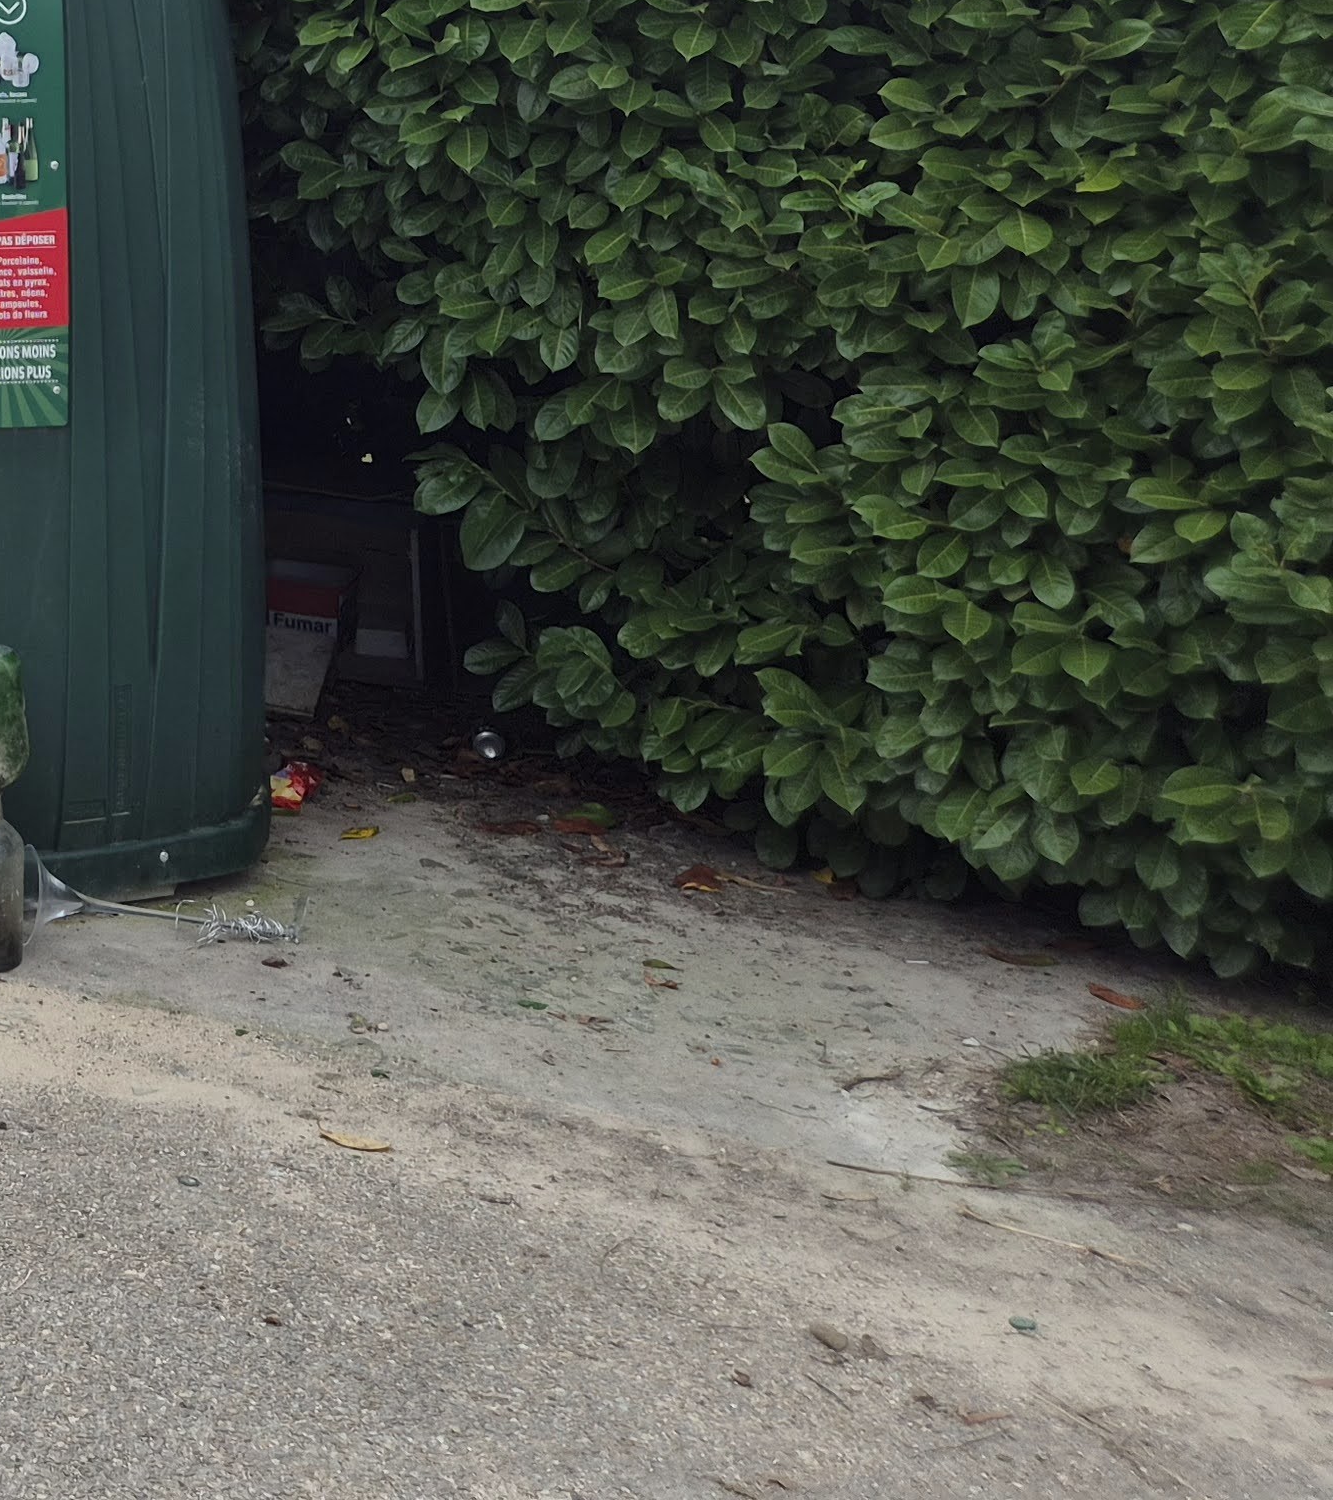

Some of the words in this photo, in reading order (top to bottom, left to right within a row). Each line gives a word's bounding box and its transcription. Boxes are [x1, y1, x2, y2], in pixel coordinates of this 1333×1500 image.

[15, 232, 55, 246] DÉPOSER
[17, 266, 57, 276] vaisselle,
[13, 279, 23, 287] en
[0, 299, 42, 310] ampoules,
[12, 310, 23, 319] de
[21, 344, 56, 359] MOINS
[26, 365, 52, 380] PLUS
[274, 612, 333, 634] Fumar
